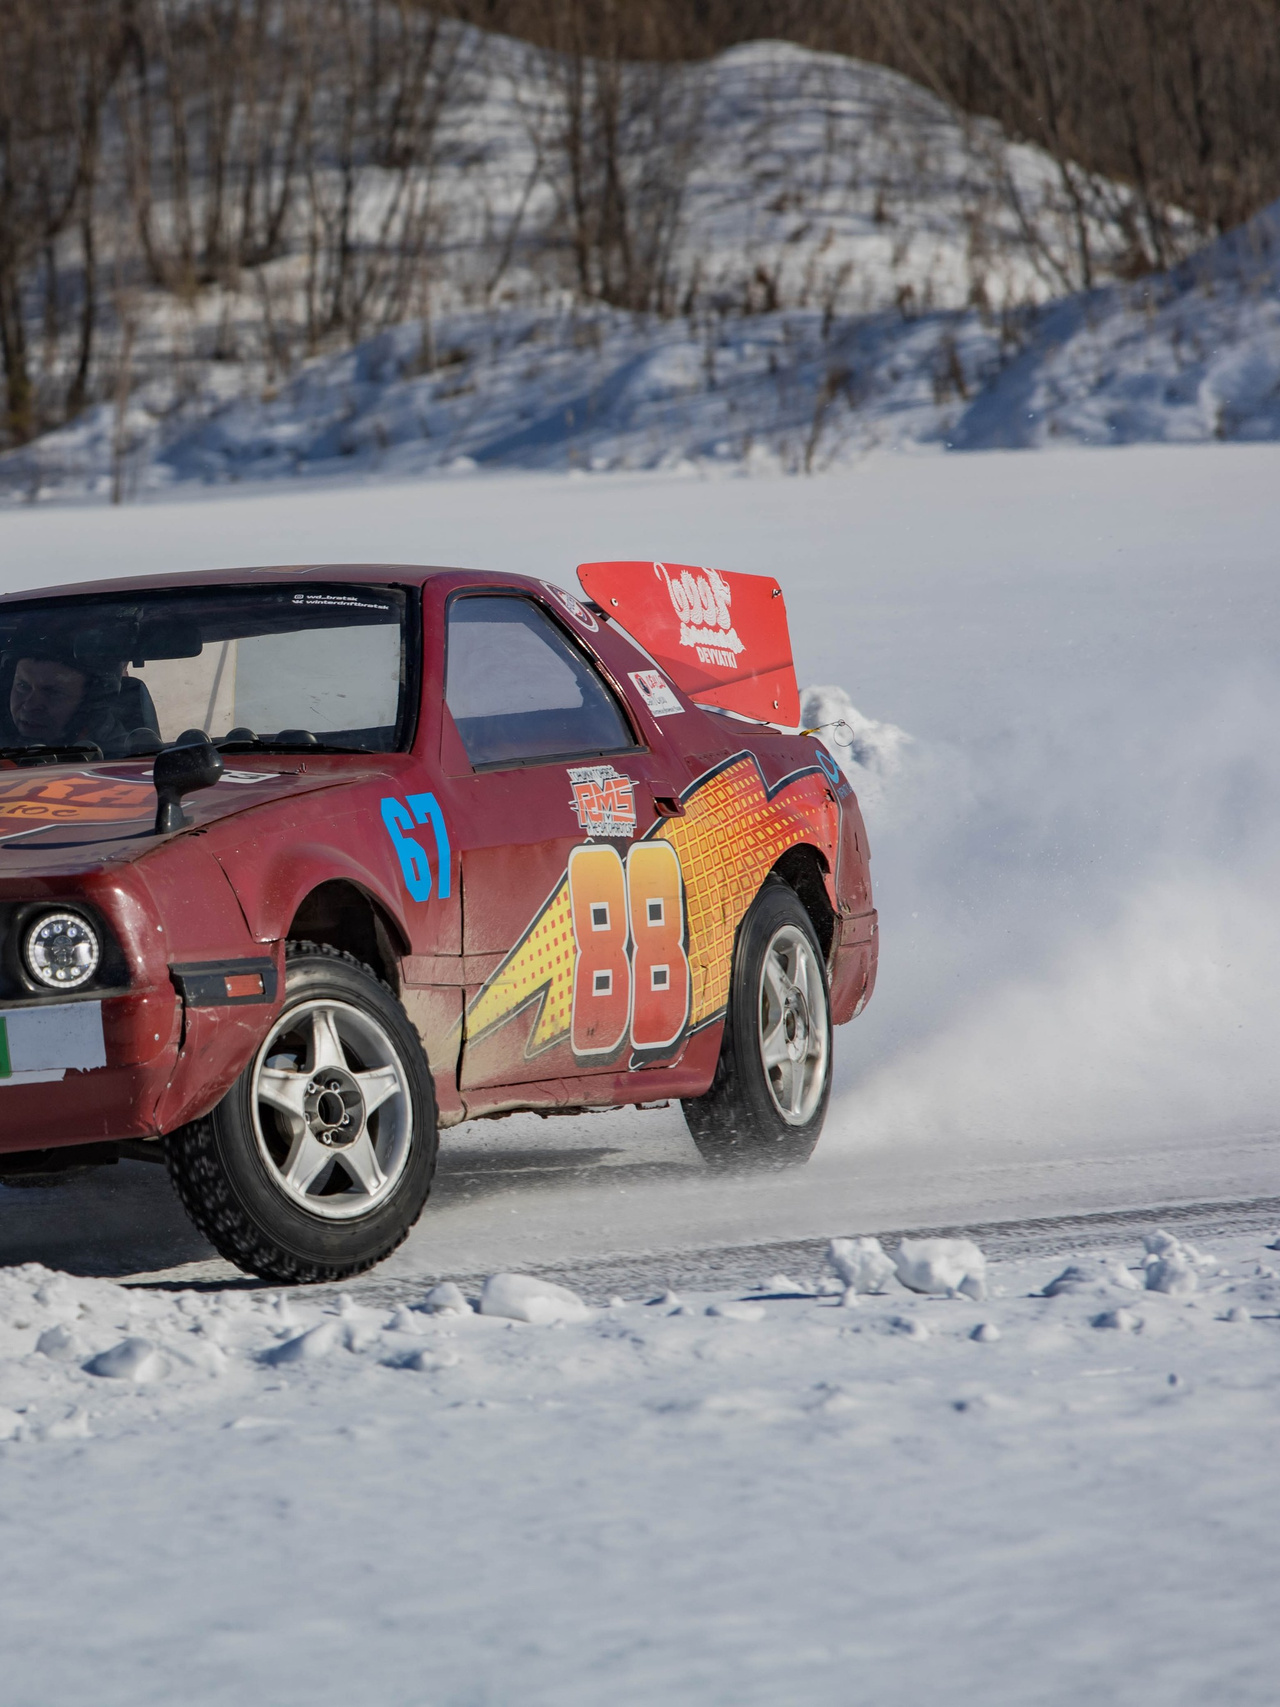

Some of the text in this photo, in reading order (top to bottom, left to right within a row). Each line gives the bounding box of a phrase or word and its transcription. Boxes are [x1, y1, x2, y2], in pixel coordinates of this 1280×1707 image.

[306, 600, 389, 610] winterdriftbratsk
[380, 791, 451, 902] 67
[568, 839, 690, 1056] 88
